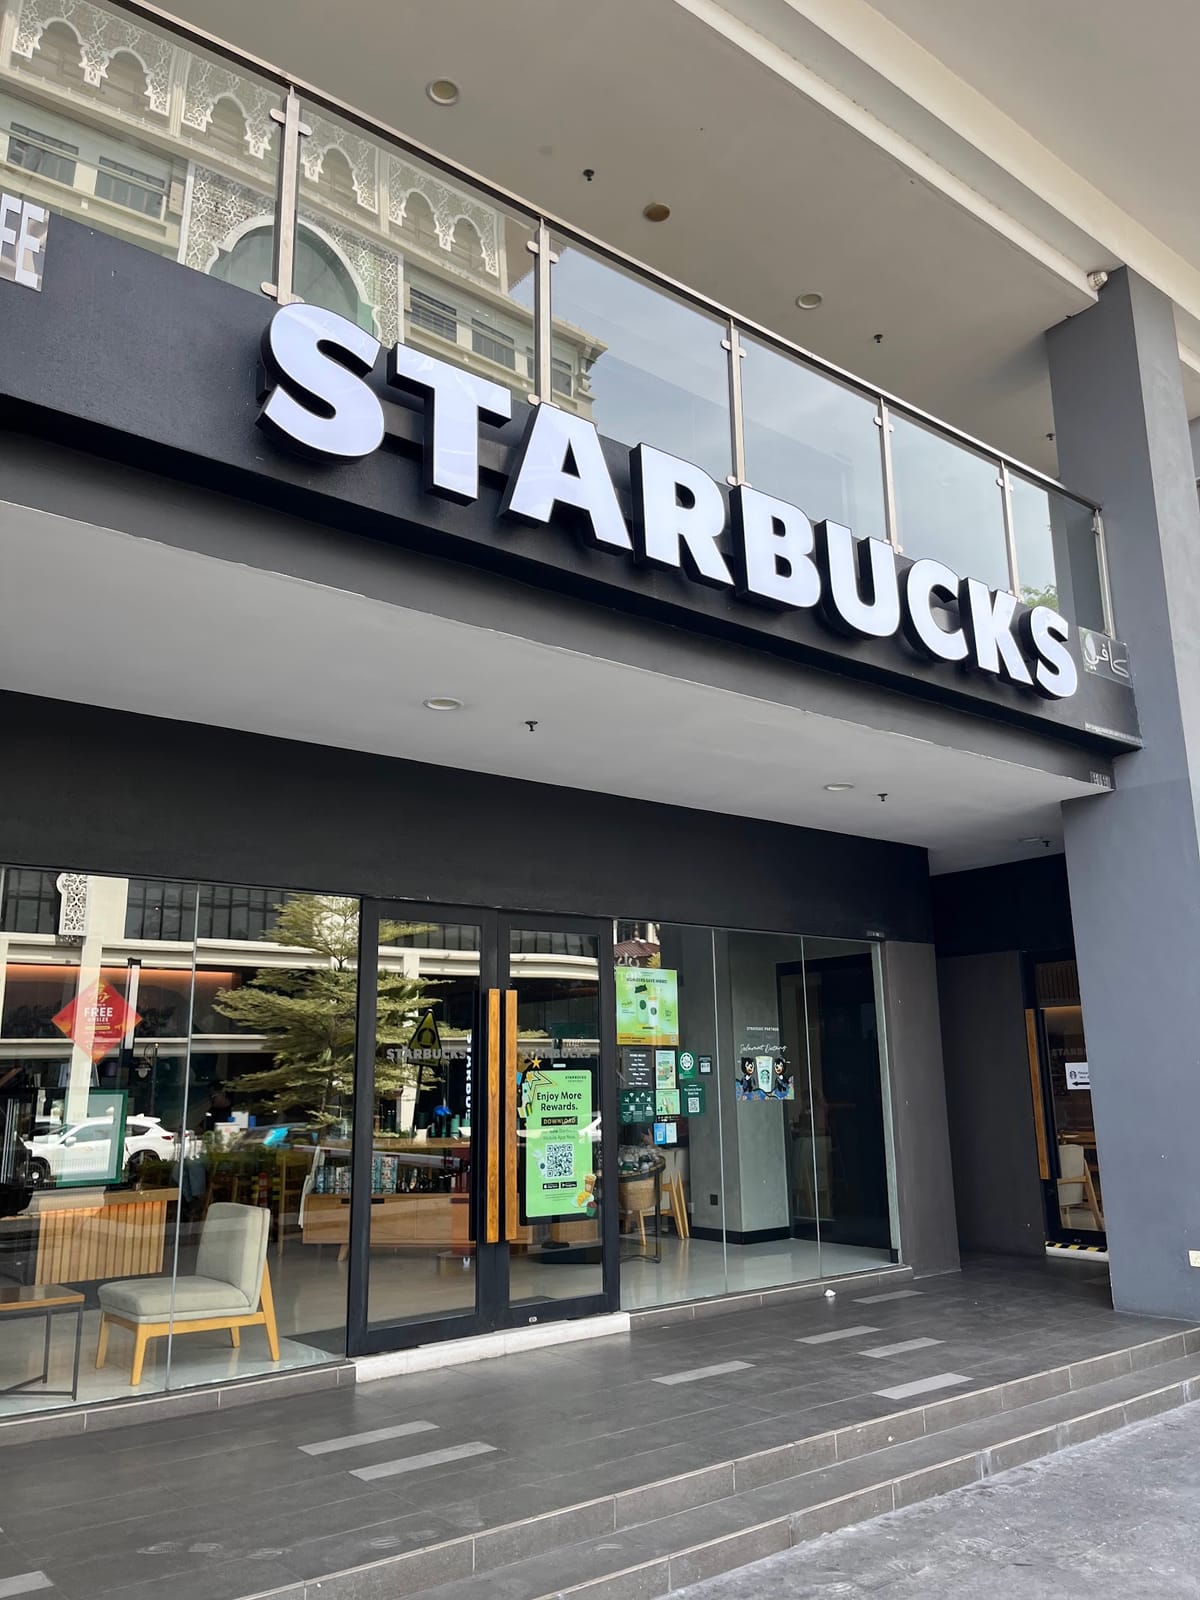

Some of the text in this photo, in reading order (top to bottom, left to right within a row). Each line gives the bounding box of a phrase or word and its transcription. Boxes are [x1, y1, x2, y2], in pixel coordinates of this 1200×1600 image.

[261, 303, 1078, 699] STARBUCKS
[84, 1007, 113, 1017] FREE
[386, 1048, 467, 1060] STARBUCKS
[536, 1091, 582, 1102] Enjoy More
[540, 1102, 578, 1112] Rewards.
[543, 1117, 576, 1125] DOWNLOAD
